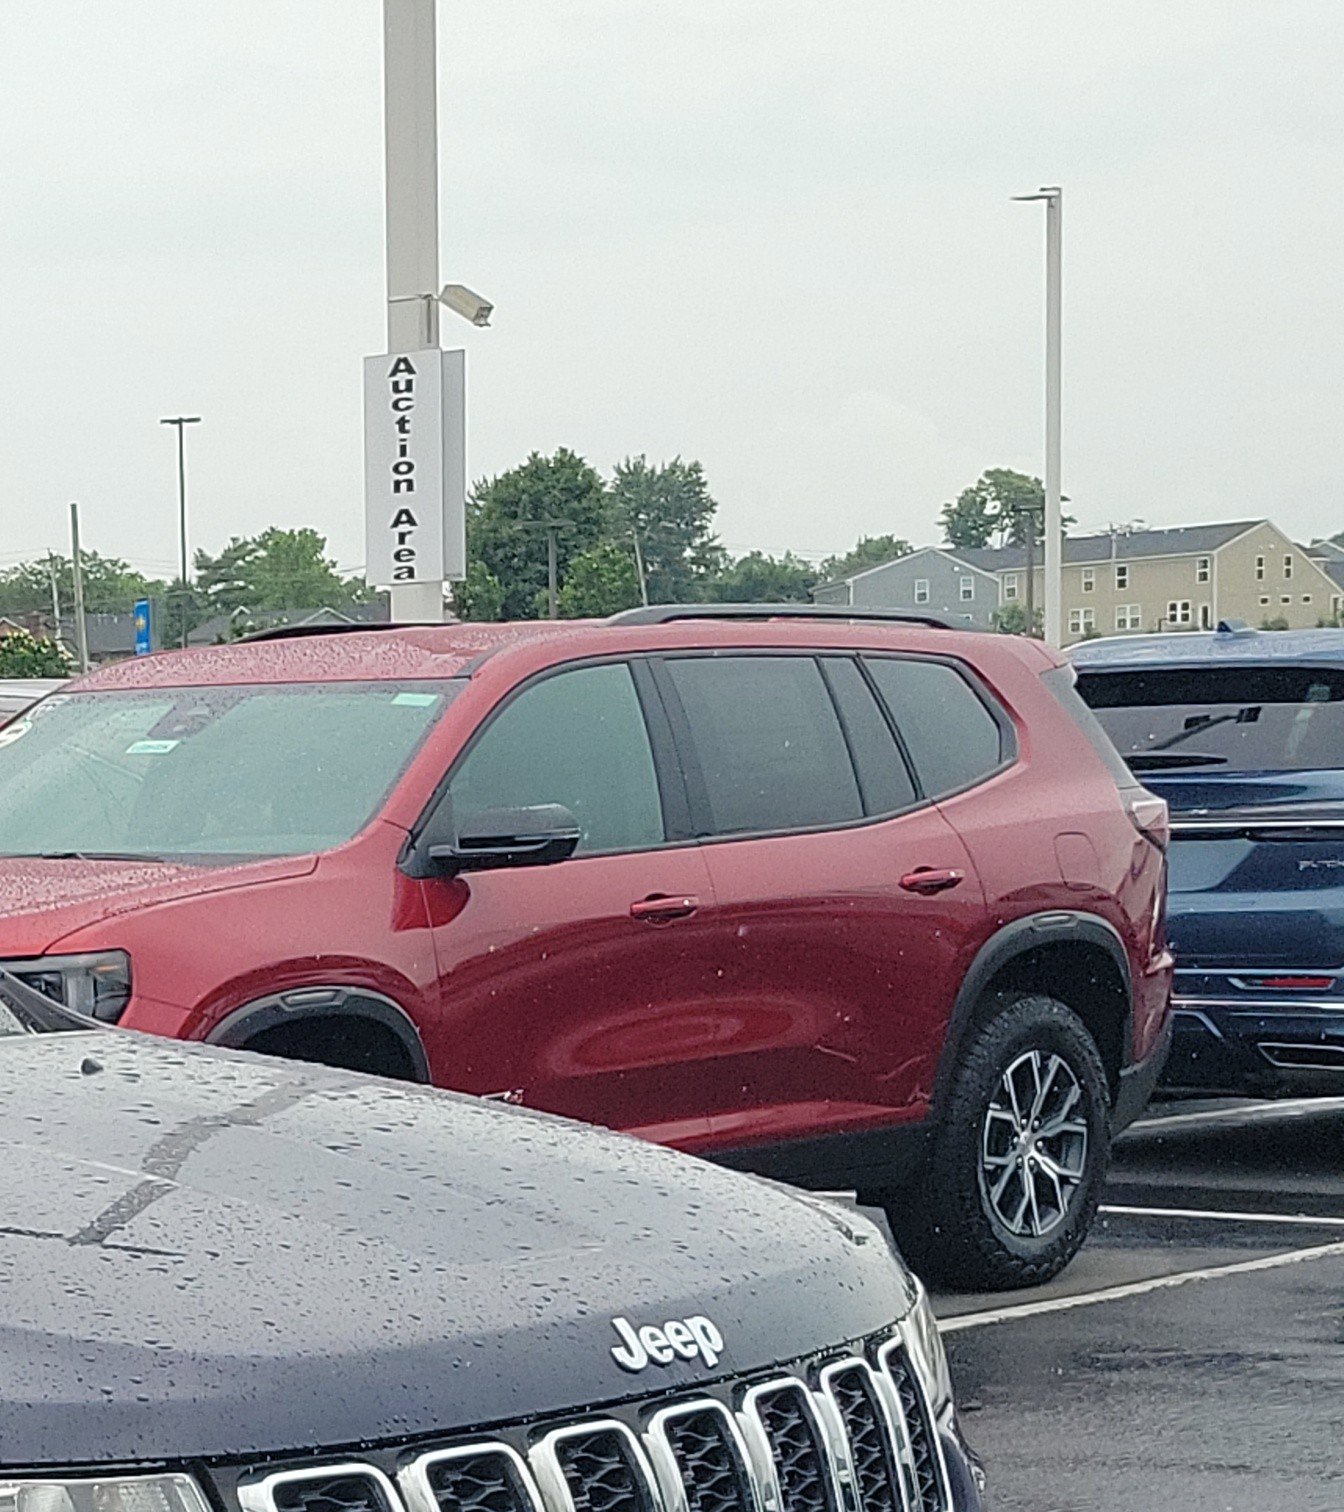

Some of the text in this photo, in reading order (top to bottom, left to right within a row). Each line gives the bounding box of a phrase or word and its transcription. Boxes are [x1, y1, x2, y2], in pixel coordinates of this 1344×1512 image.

[388, 356, 419, 581] Auction Area
[610, 1315, 725, 1371] Jeep
